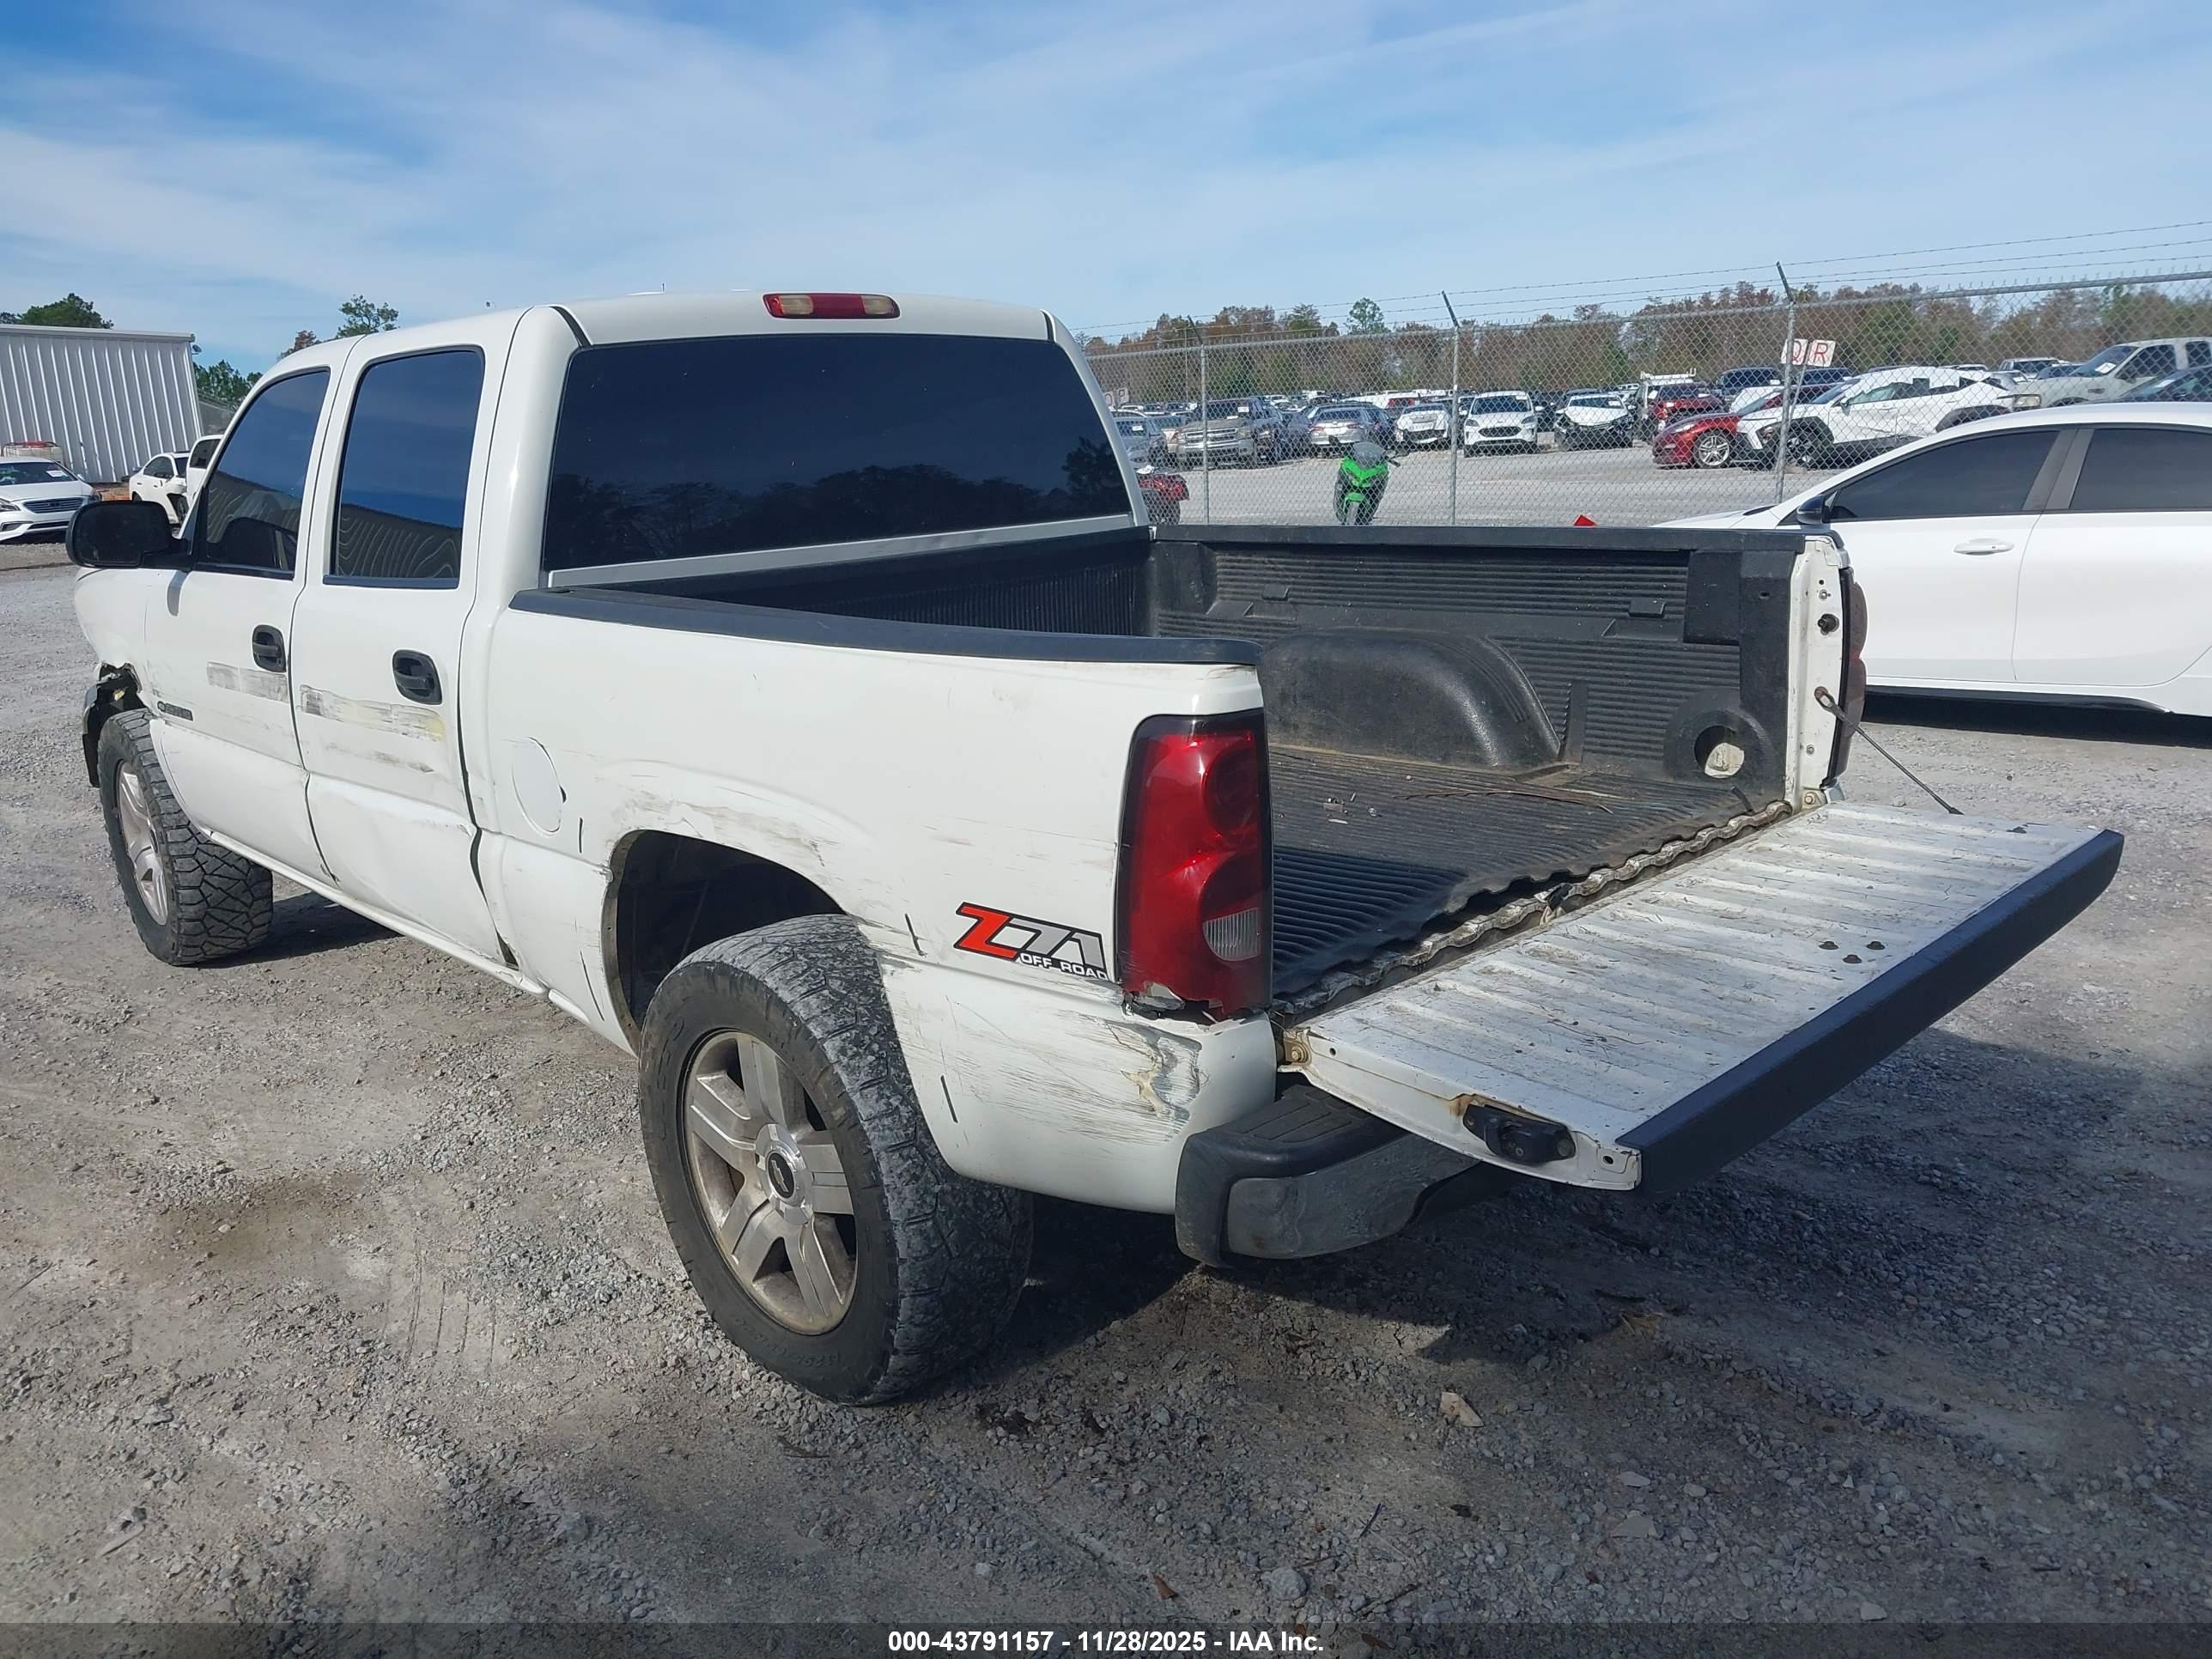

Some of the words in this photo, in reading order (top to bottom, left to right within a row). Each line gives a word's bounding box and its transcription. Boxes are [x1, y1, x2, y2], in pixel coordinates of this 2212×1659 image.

[1811, 342, 1829, 364] R
[953, 902, 1107, 970] Z71
[1019, 952, 1053, 968] OFF
[1060, 961, 1109, 981] ROAD
